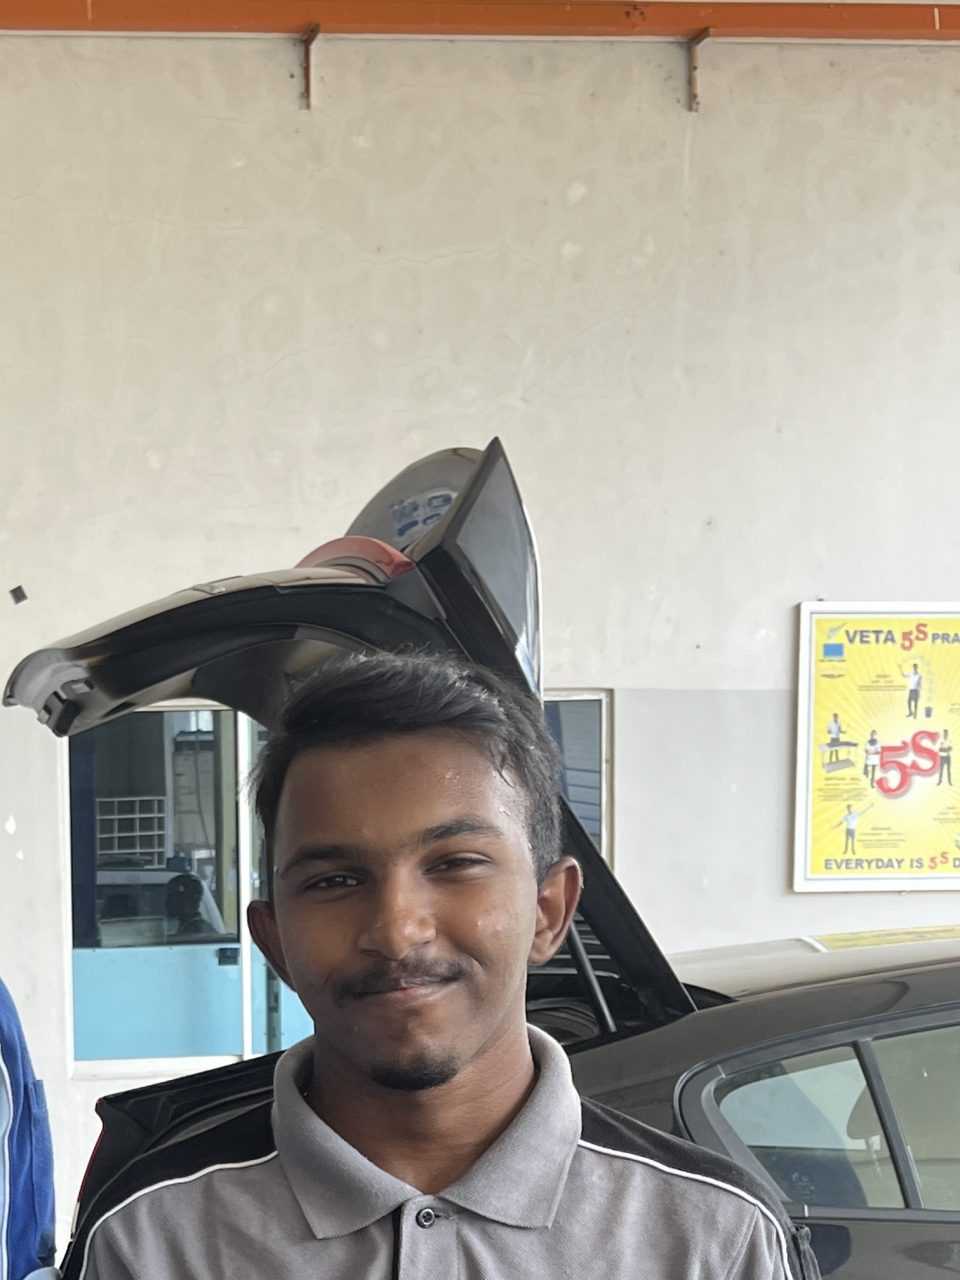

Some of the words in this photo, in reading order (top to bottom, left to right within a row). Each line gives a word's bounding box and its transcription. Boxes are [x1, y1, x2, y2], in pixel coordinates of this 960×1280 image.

[845, 629, 896, 644] VETA
[900, 623, 928, 651] 5S
[876, 730, 940, 798] 5S
[824, 858, 905, 870] EVERYDAY
[910, 858, 924, 869] IS
[928, 851, 949, 870] 5S
